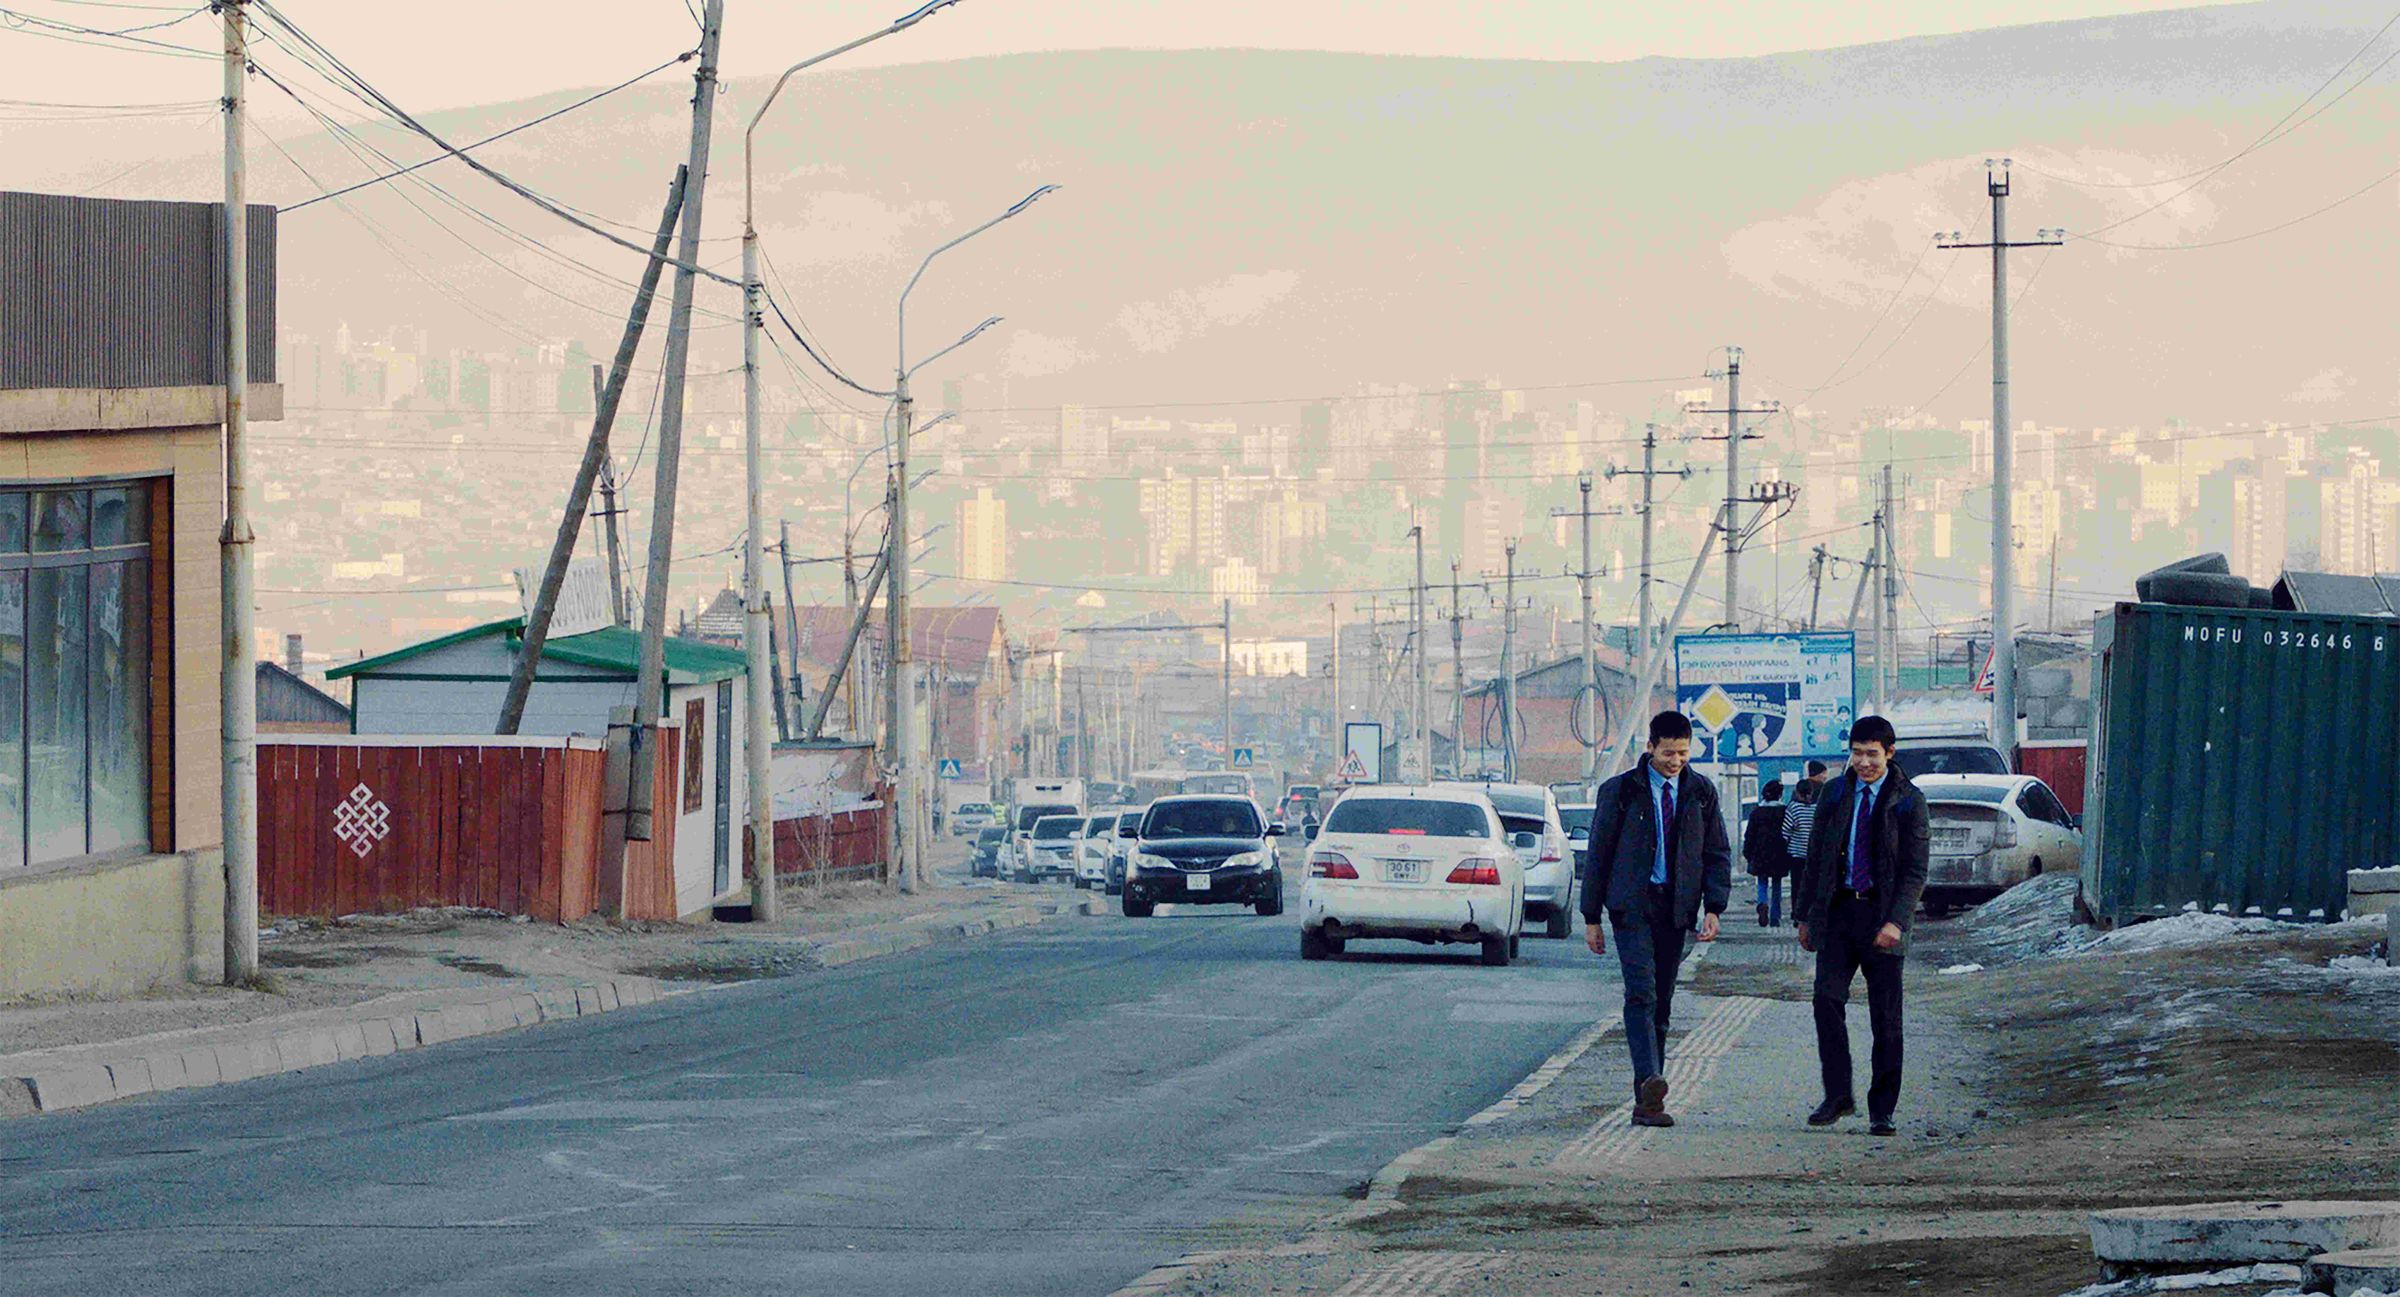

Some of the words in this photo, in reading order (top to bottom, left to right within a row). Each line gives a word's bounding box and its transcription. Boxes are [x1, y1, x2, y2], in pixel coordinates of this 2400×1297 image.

[2185, 626, 2241, 643] MOFU
[2264, 631, 2351, 649] 032646
[2374, 637, 2384, 650] 6
